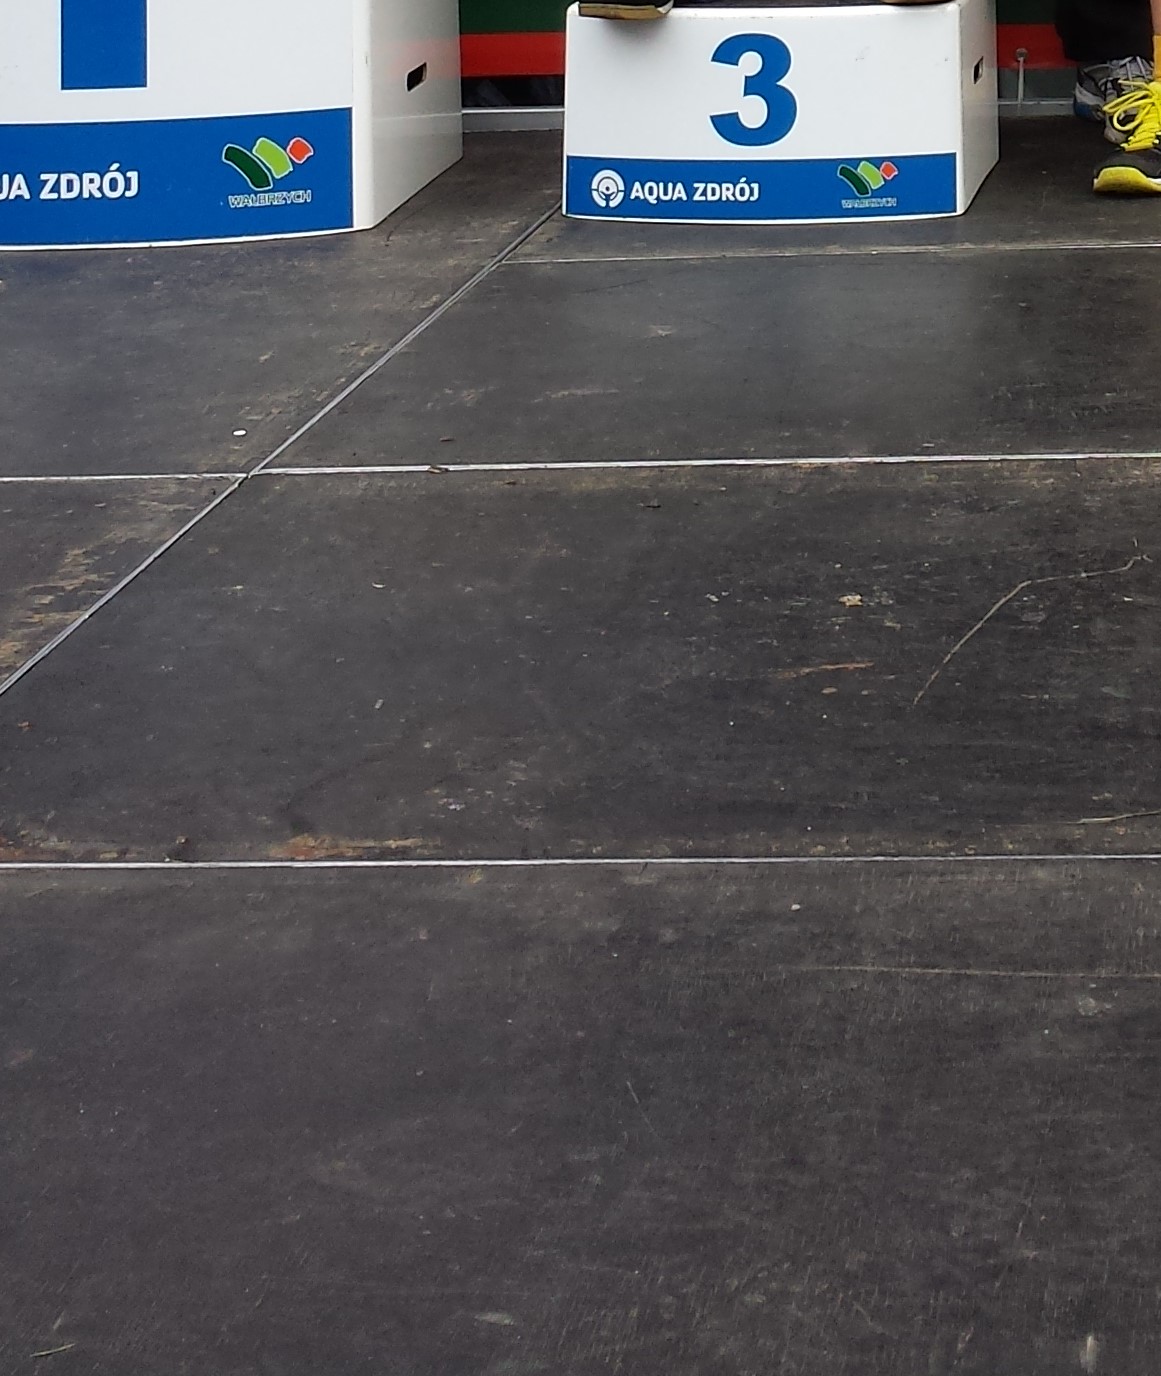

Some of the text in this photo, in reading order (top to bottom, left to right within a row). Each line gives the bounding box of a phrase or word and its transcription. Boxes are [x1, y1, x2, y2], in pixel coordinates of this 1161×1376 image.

[709, 32, 798, 147] 3
[39, 162, 139, 199] ZDRÓJ
[630, 176, 760, 205] AQUA ZDRÓJ
